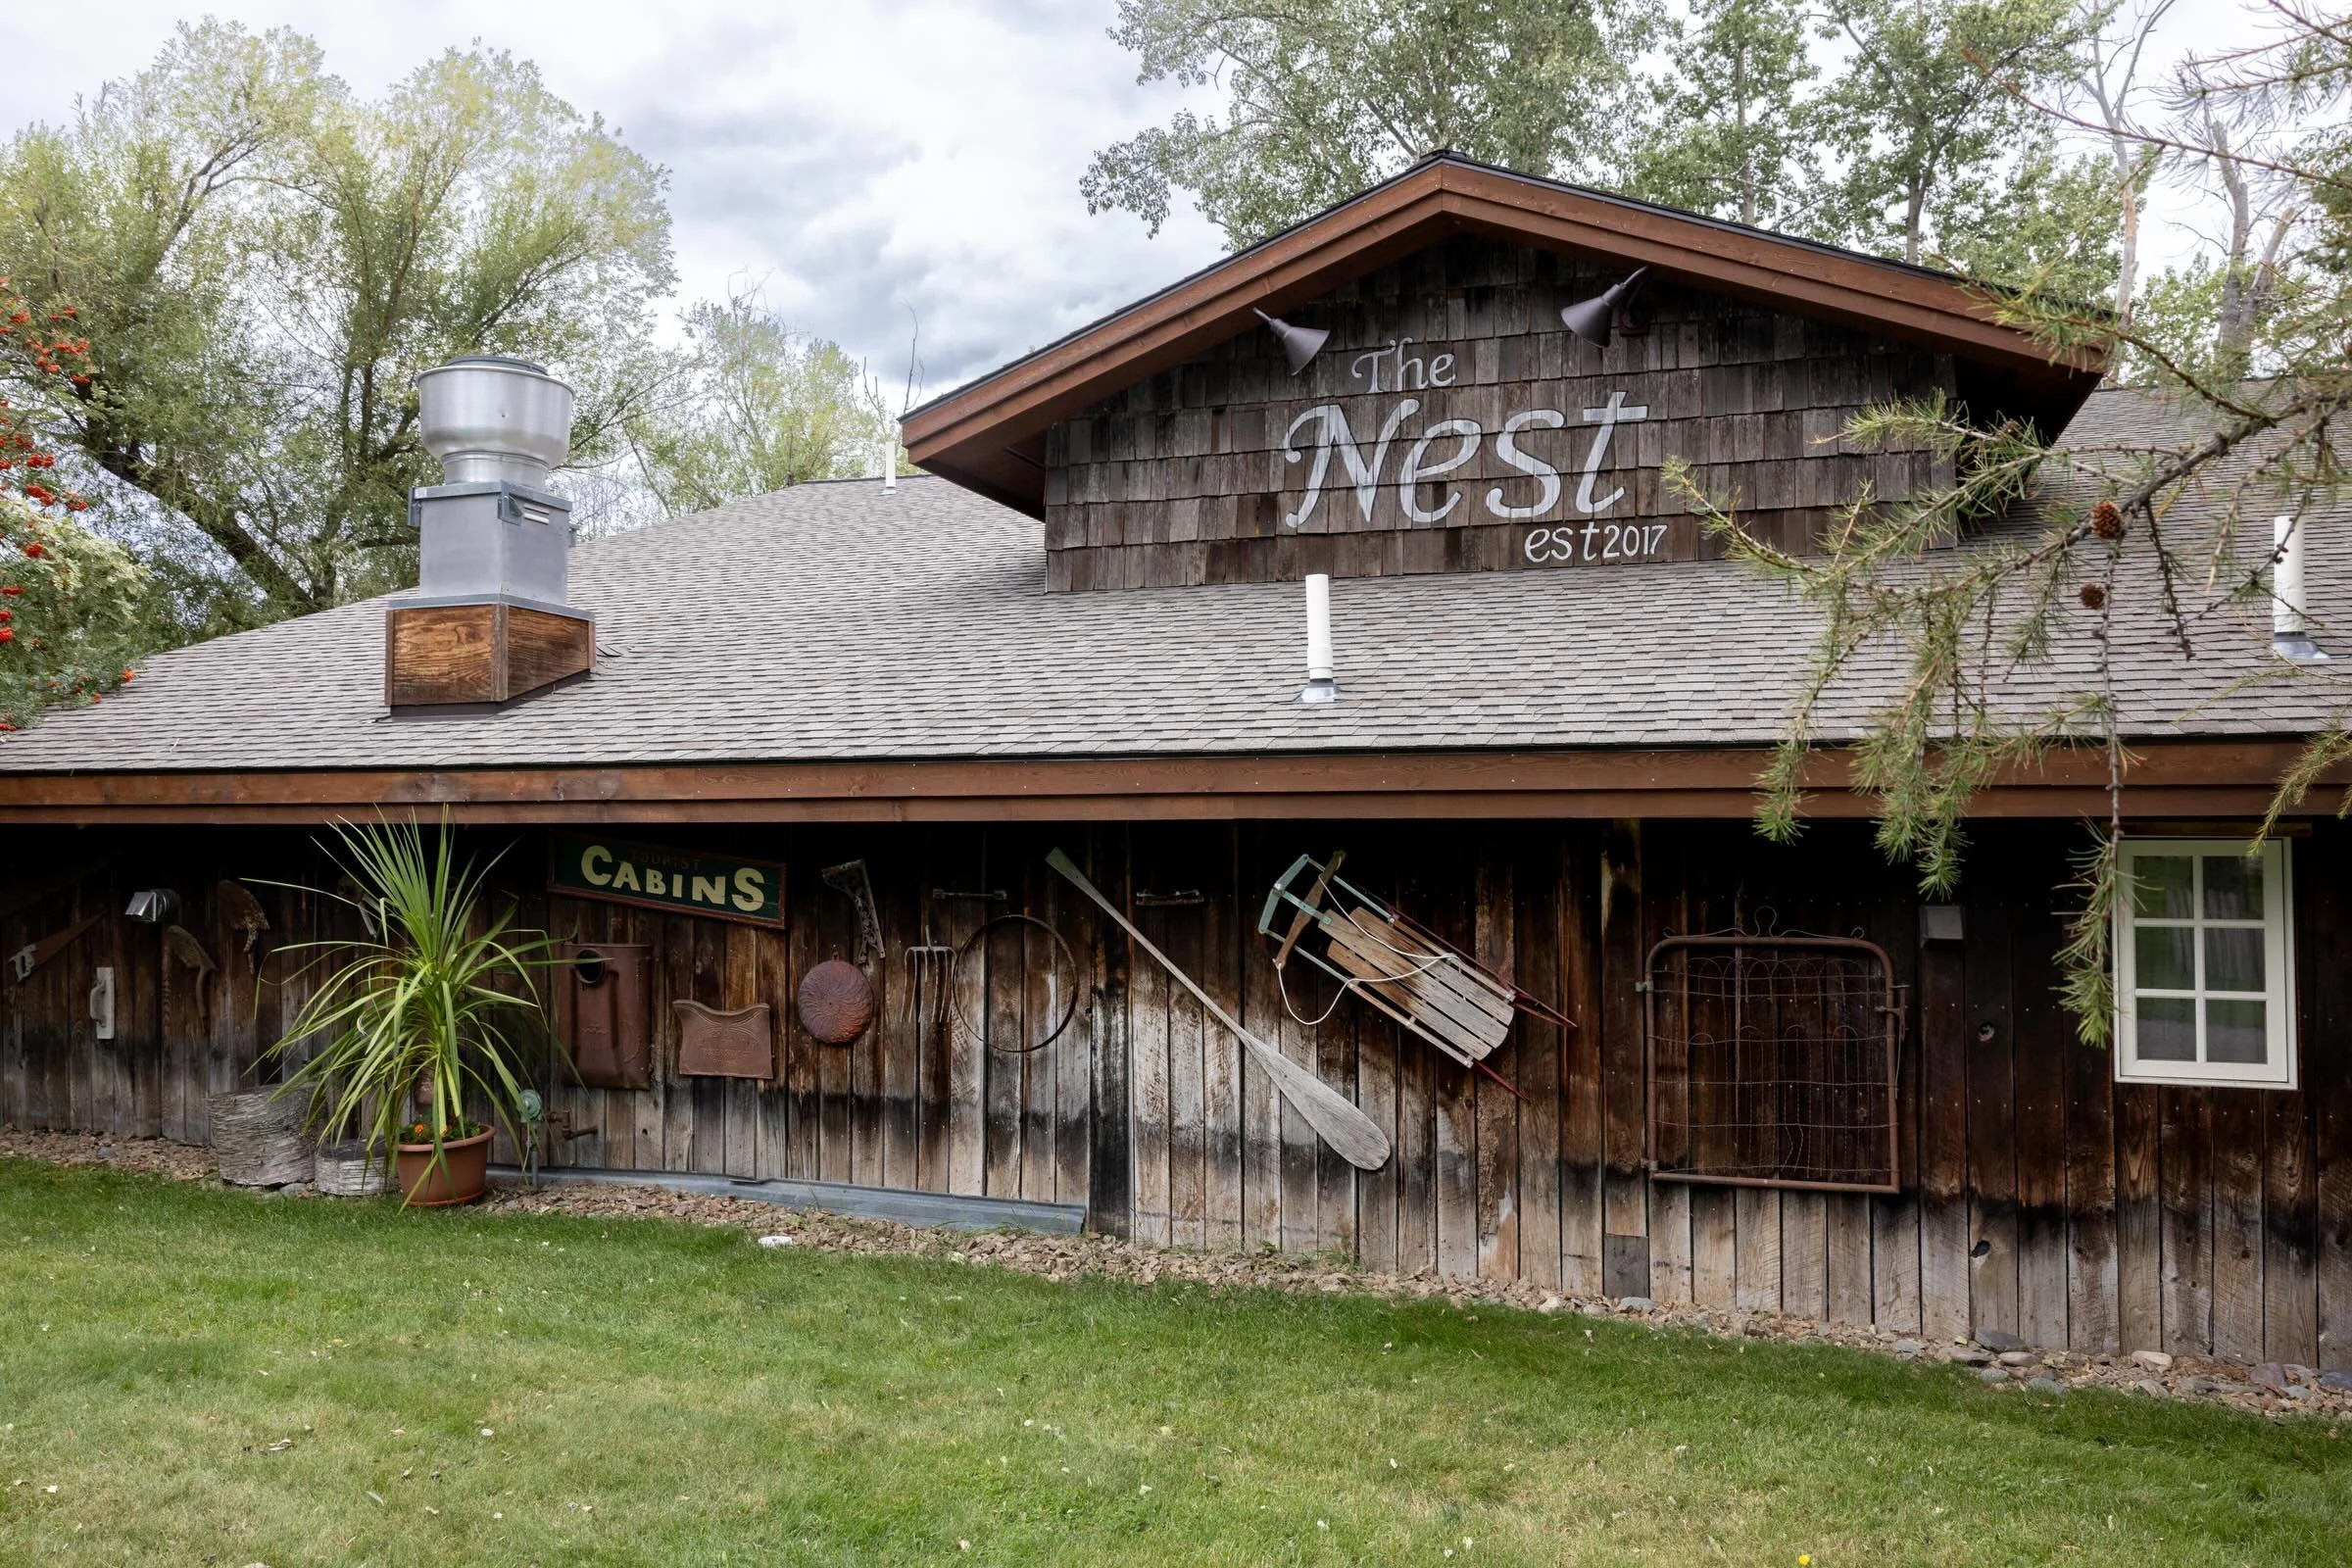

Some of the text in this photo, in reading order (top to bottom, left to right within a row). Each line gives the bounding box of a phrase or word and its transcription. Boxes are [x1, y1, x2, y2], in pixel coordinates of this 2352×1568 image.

[1351, 337, 1456, 393] The
[1285, 392, 1648, 528] Nest
[580, 845, 765, 911] CABINS
[631, 849, 703, 871] TOURIST
